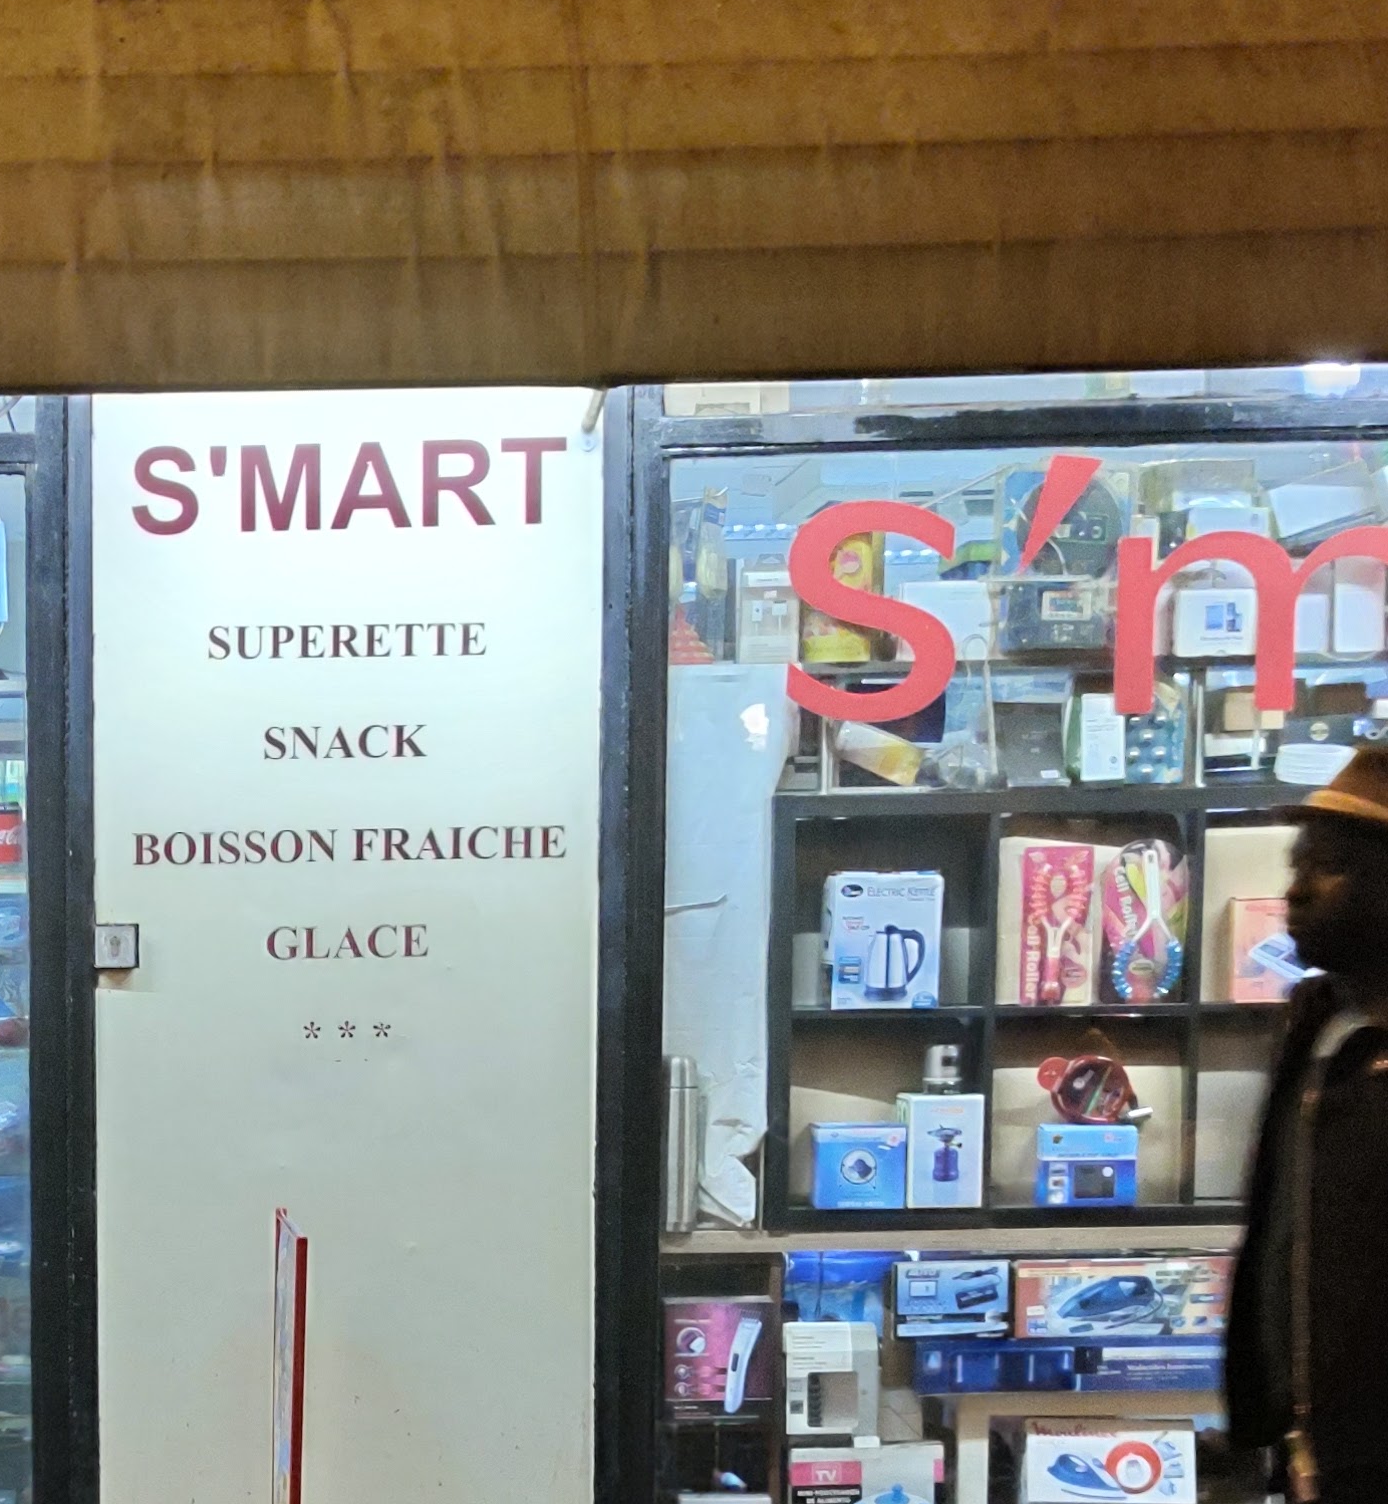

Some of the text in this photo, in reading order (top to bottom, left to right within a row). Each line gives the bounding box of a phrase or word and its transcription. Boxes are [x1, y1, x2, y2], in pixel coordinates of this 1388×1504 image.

[130, 436, 568, 537] S'MART
[207, 622, 487, 661] SUPERETTE
[263, 724, 428, 761] SNACK
[131, 824, 567, 866] BOISSON FRAICHE
[266, 923, 429, 961] GLACE
[816, 1469, 838, 1482] TV
